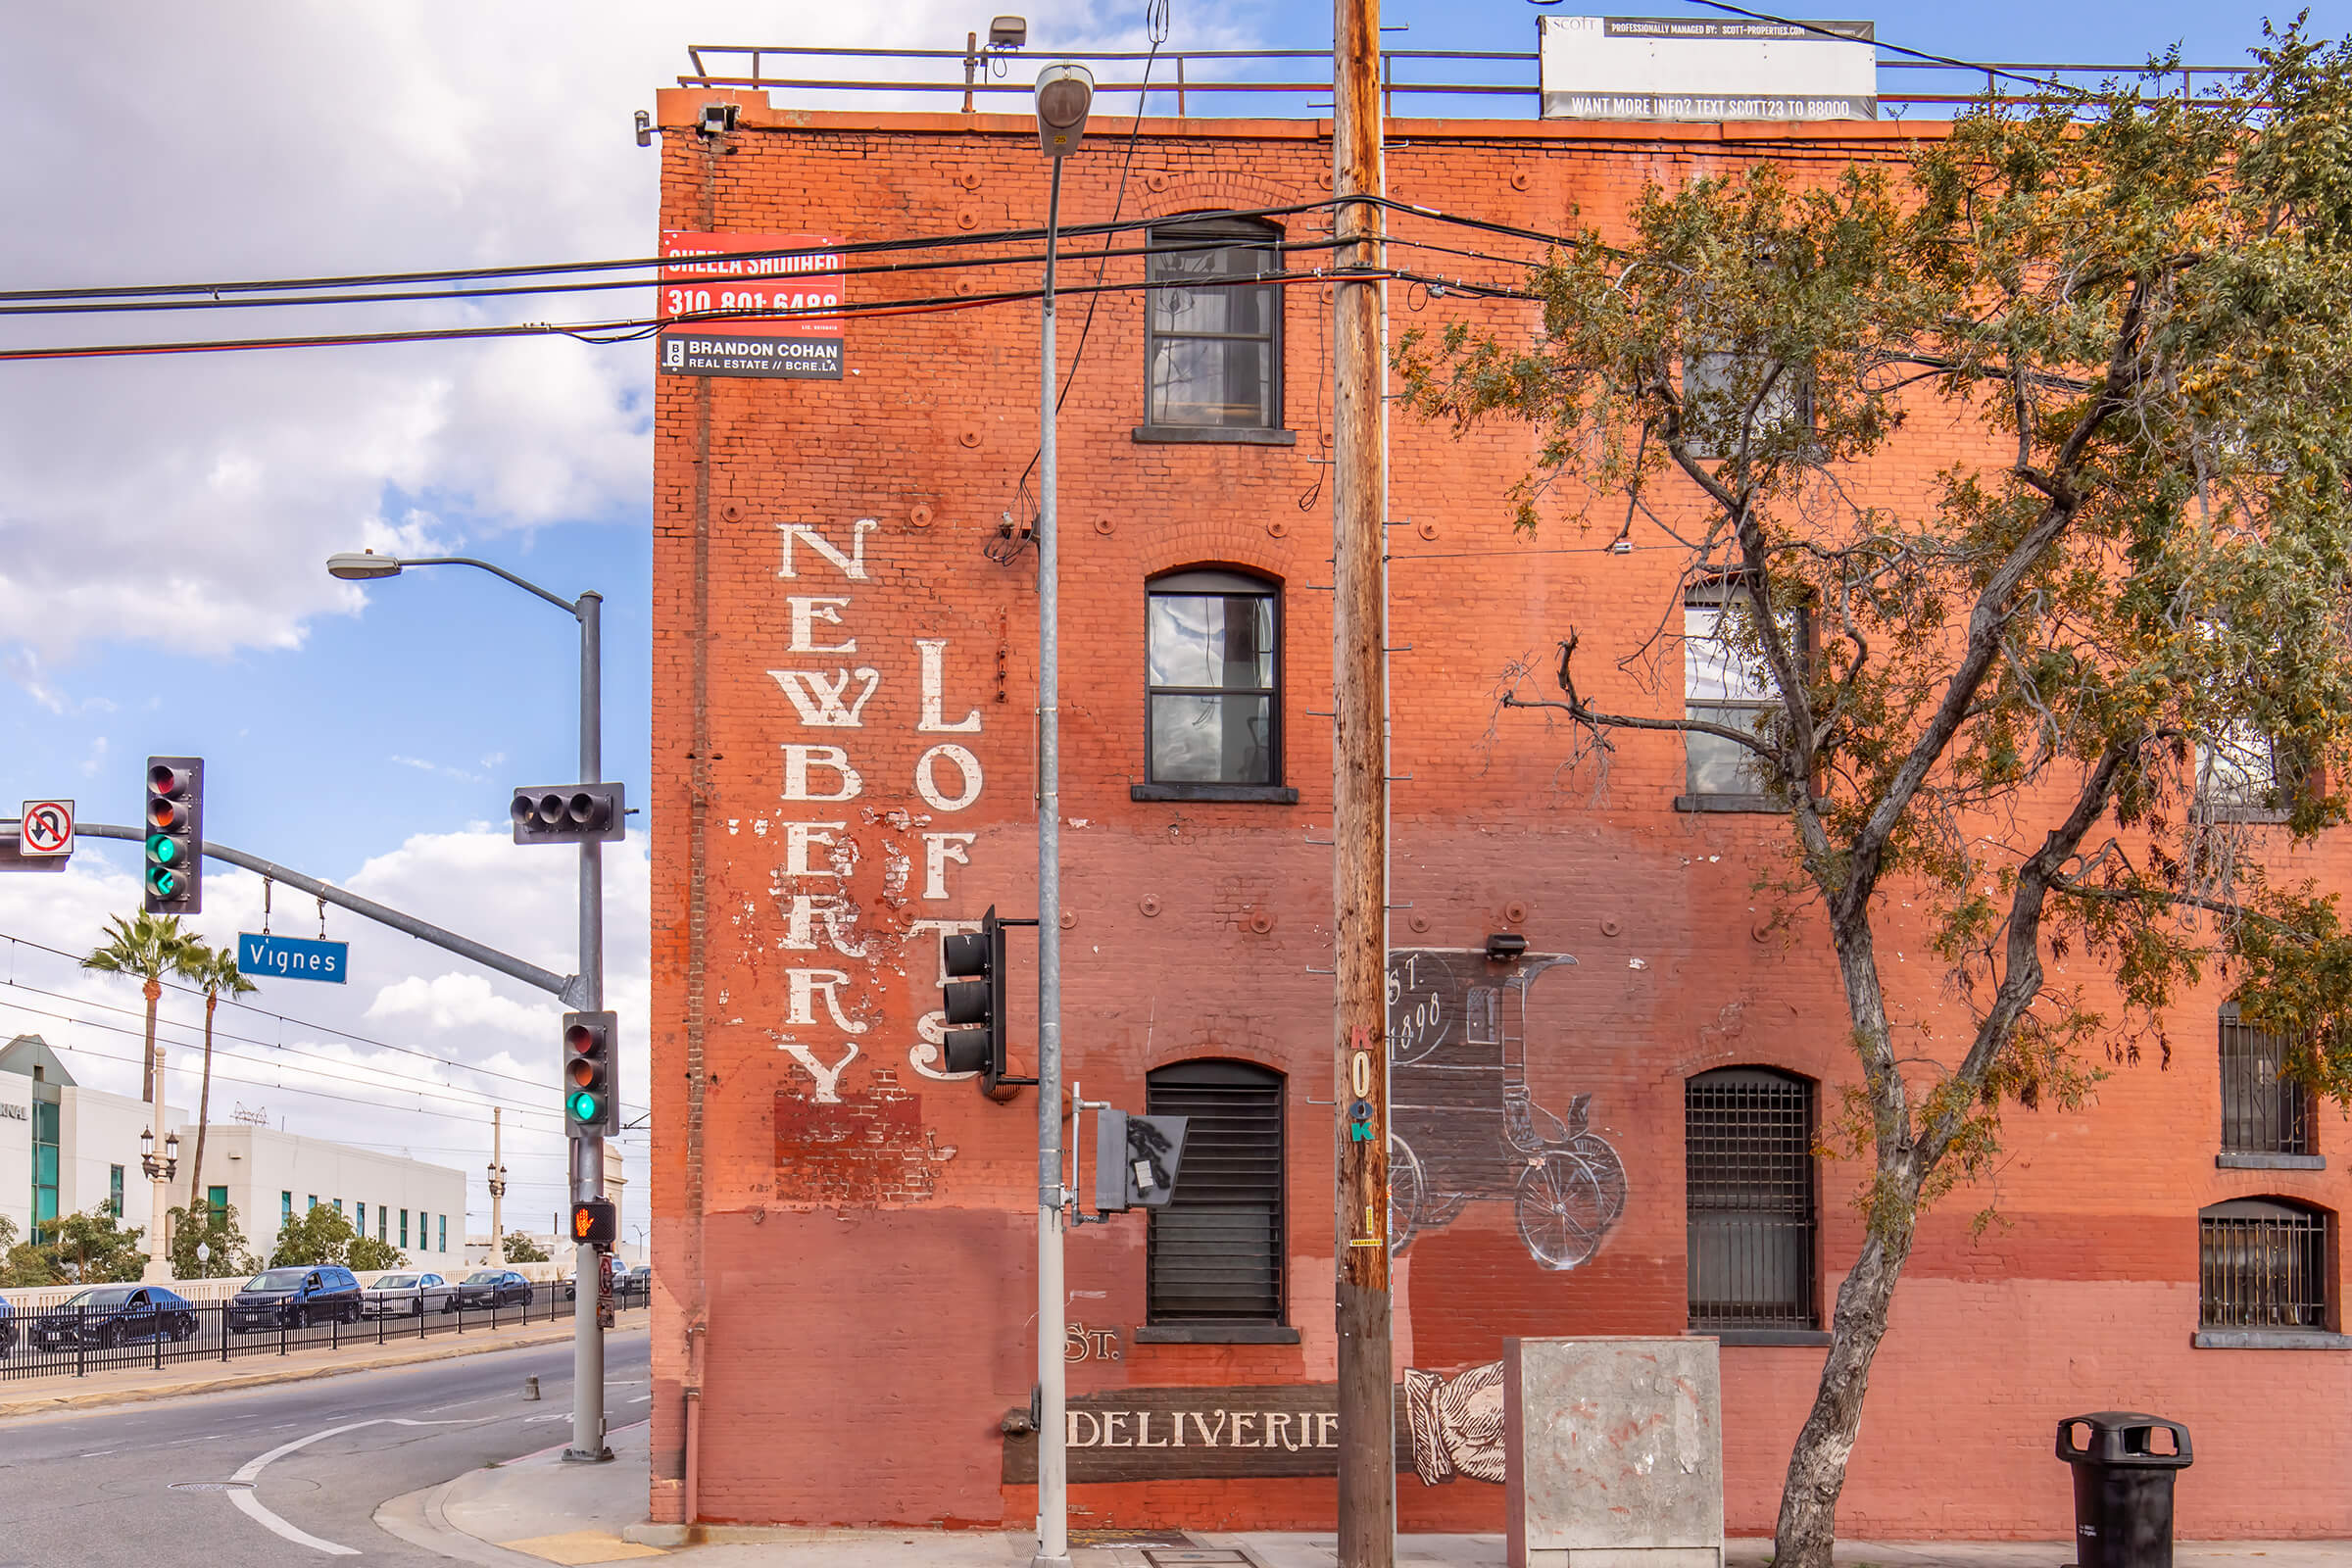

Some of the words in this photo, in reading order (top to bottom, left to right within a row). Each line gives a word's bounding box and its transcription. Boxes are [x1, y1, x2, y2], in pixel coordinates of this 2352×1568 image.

[1611, 23, 1669, 33] PROFESSIONALLY
[1671, 24, 1704, 34] MANAGED
[1705, 24, 1718, 34] BY:
[1722, 25, 1805, 35] SCOTT-PROPERTIES.COM
[1571, 97, 1609, 114] WANT
[1613, 98, 1650, 115] MORE
[1653, 99, 1691, 115] INFO?
[1695, 99, 1725, 116] TEXT
[1729, 100, 1785, 116] SCOTT23
[1788, 100, 1804, 116] TO
[1807, 100, 1850, 117] 88000
[689, 340, 773, 357] BRANDON
[777, 343, 838, 359] COHAN
[689, 358, 720, 368] REAL
[724, 359, 769, 369] ESTATE
[785, 361, 837, 371] BCRE.LA
[766, 518, 880, 1104] NEWBERRY
[250, 944, 335, 974] Vignes
[1391, 991, 1441, 1060] 1898
